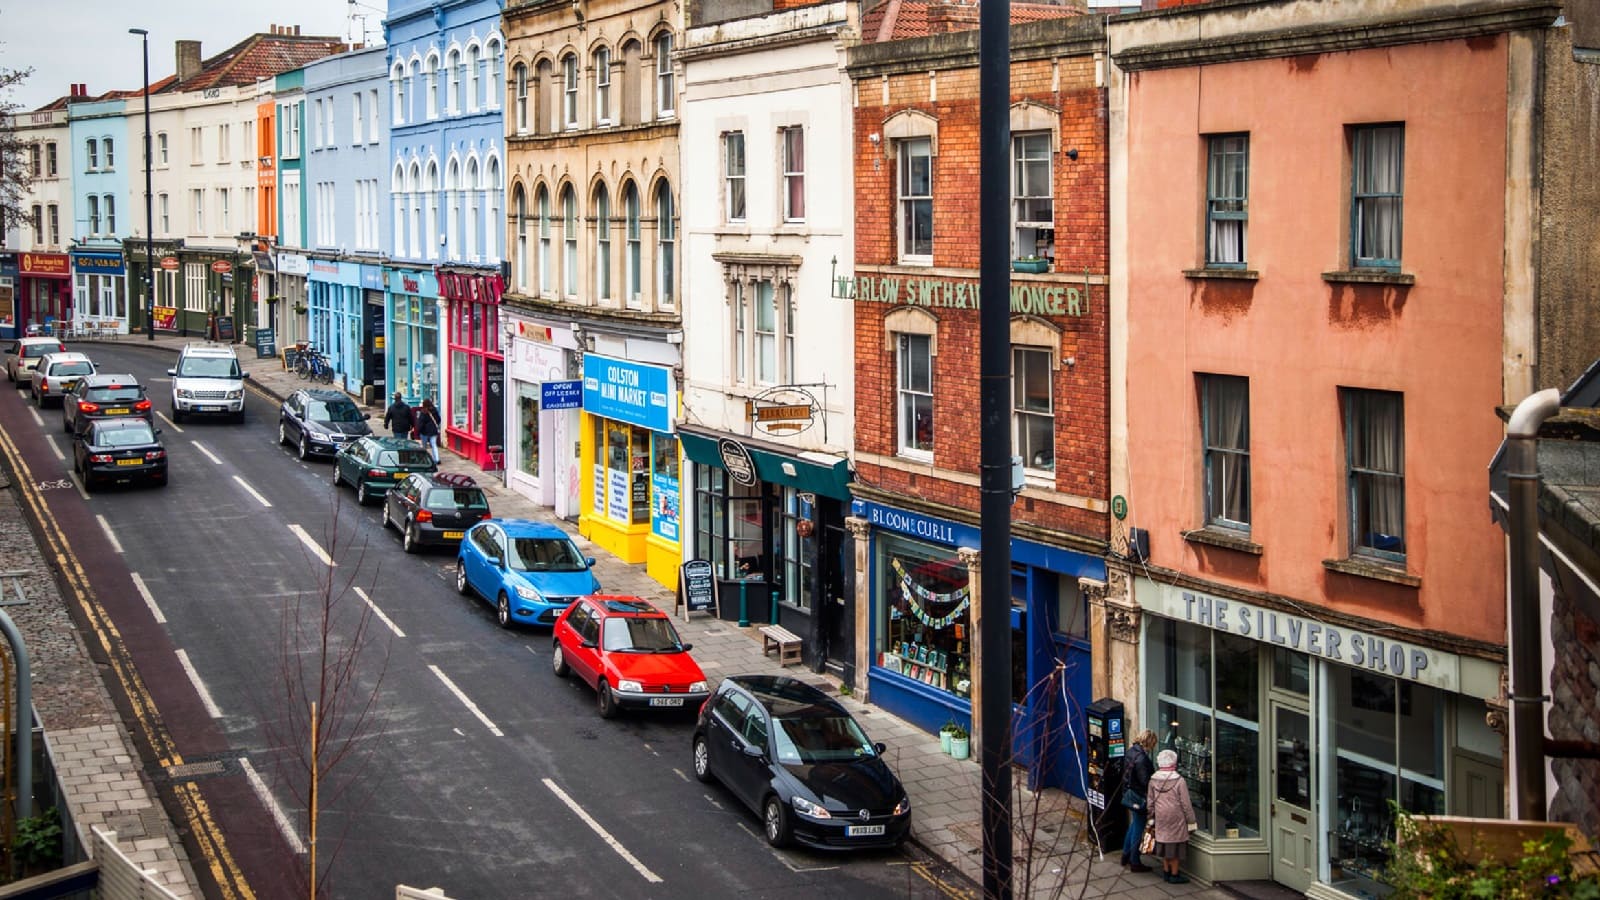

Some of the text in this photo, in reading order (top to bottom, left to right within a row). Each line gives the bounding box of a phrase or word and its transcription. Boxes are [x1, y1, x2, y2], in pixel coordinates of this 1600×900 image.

[607, 366, 639, 387] COLSTON
[600, 382, 617, 401] MINI
[618, 386, 647, 408] MARKET
[872, 508, 910, 532] BLOOM
[917, 519, 955, 542] CURLL
[1182, 591, 1428, 680] THE SILVER SHOP
[1111, 720, 1119, 731] P
